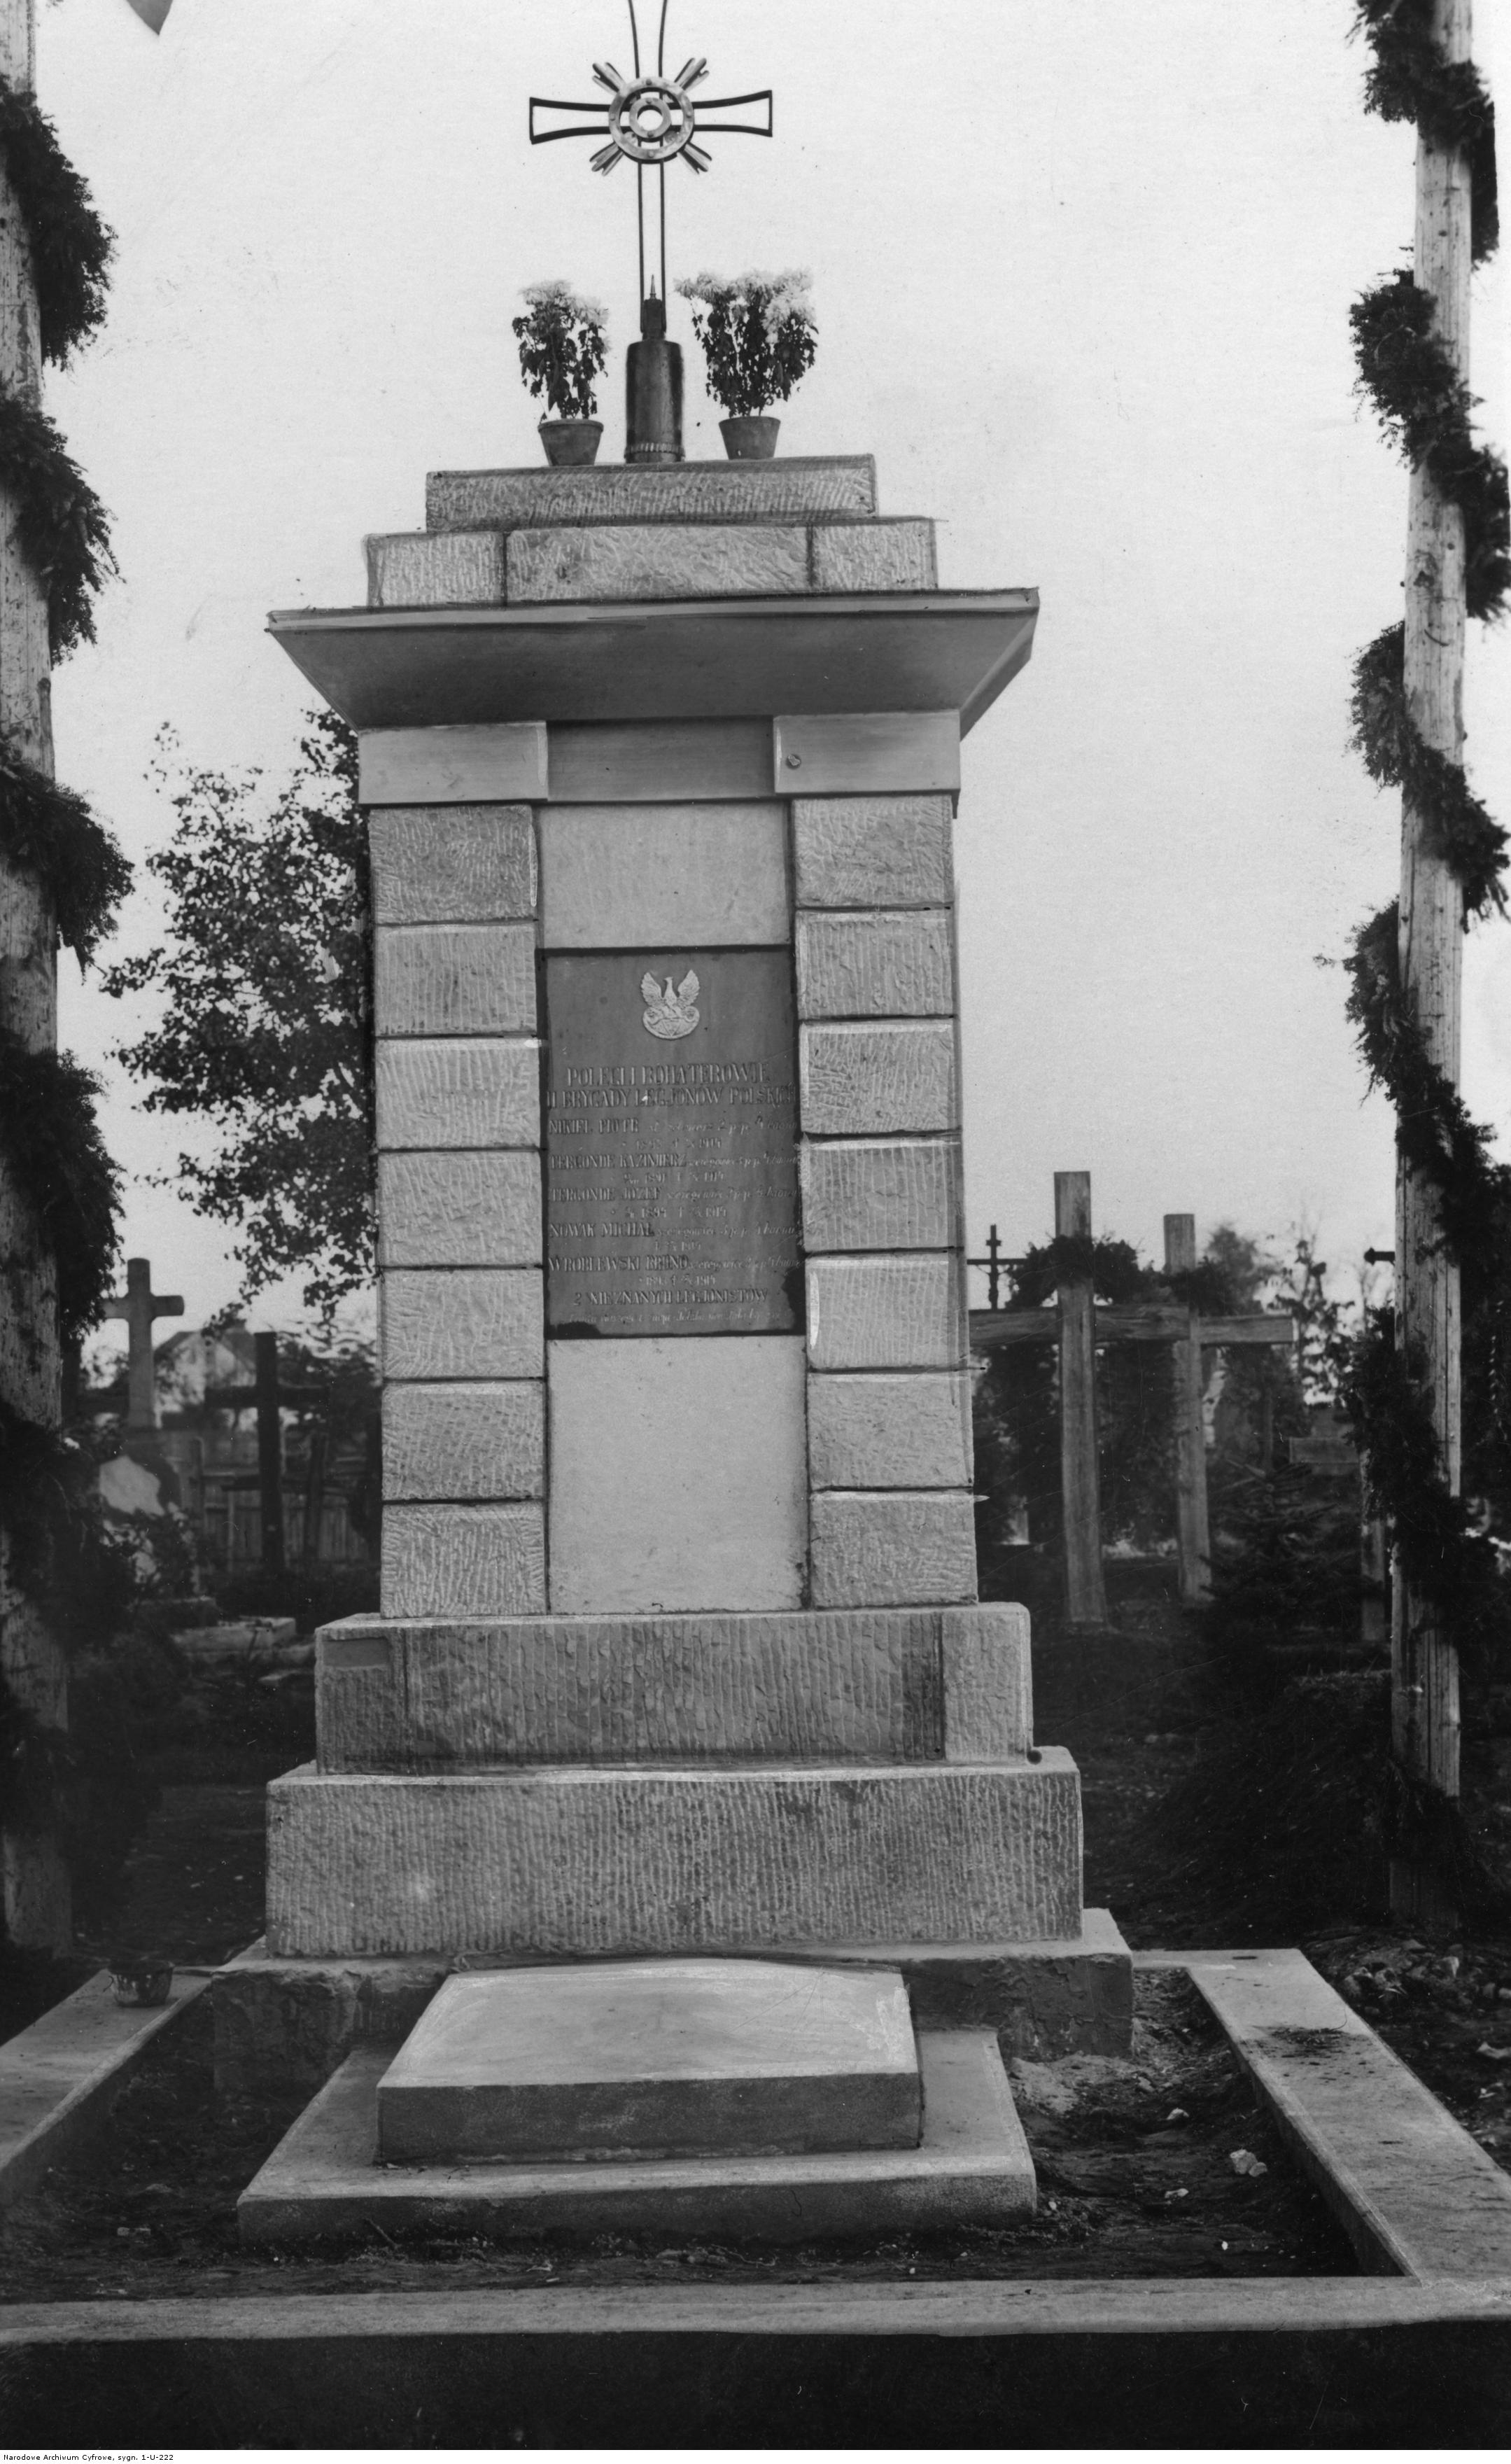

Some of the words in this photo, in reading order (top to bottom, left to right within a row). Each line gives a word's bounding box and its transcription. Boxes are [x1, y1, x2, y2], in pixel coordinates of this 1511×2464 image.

[562, 1089, 631, 1108] BRYGADY
[598, 1117, 639, 1135] PIOTR
[619, 1153, 687, 1168] KAZIMIERZ
[549, 1223, 595, 1238] NOWAK
[573, 1293, 582, 1306] 2
